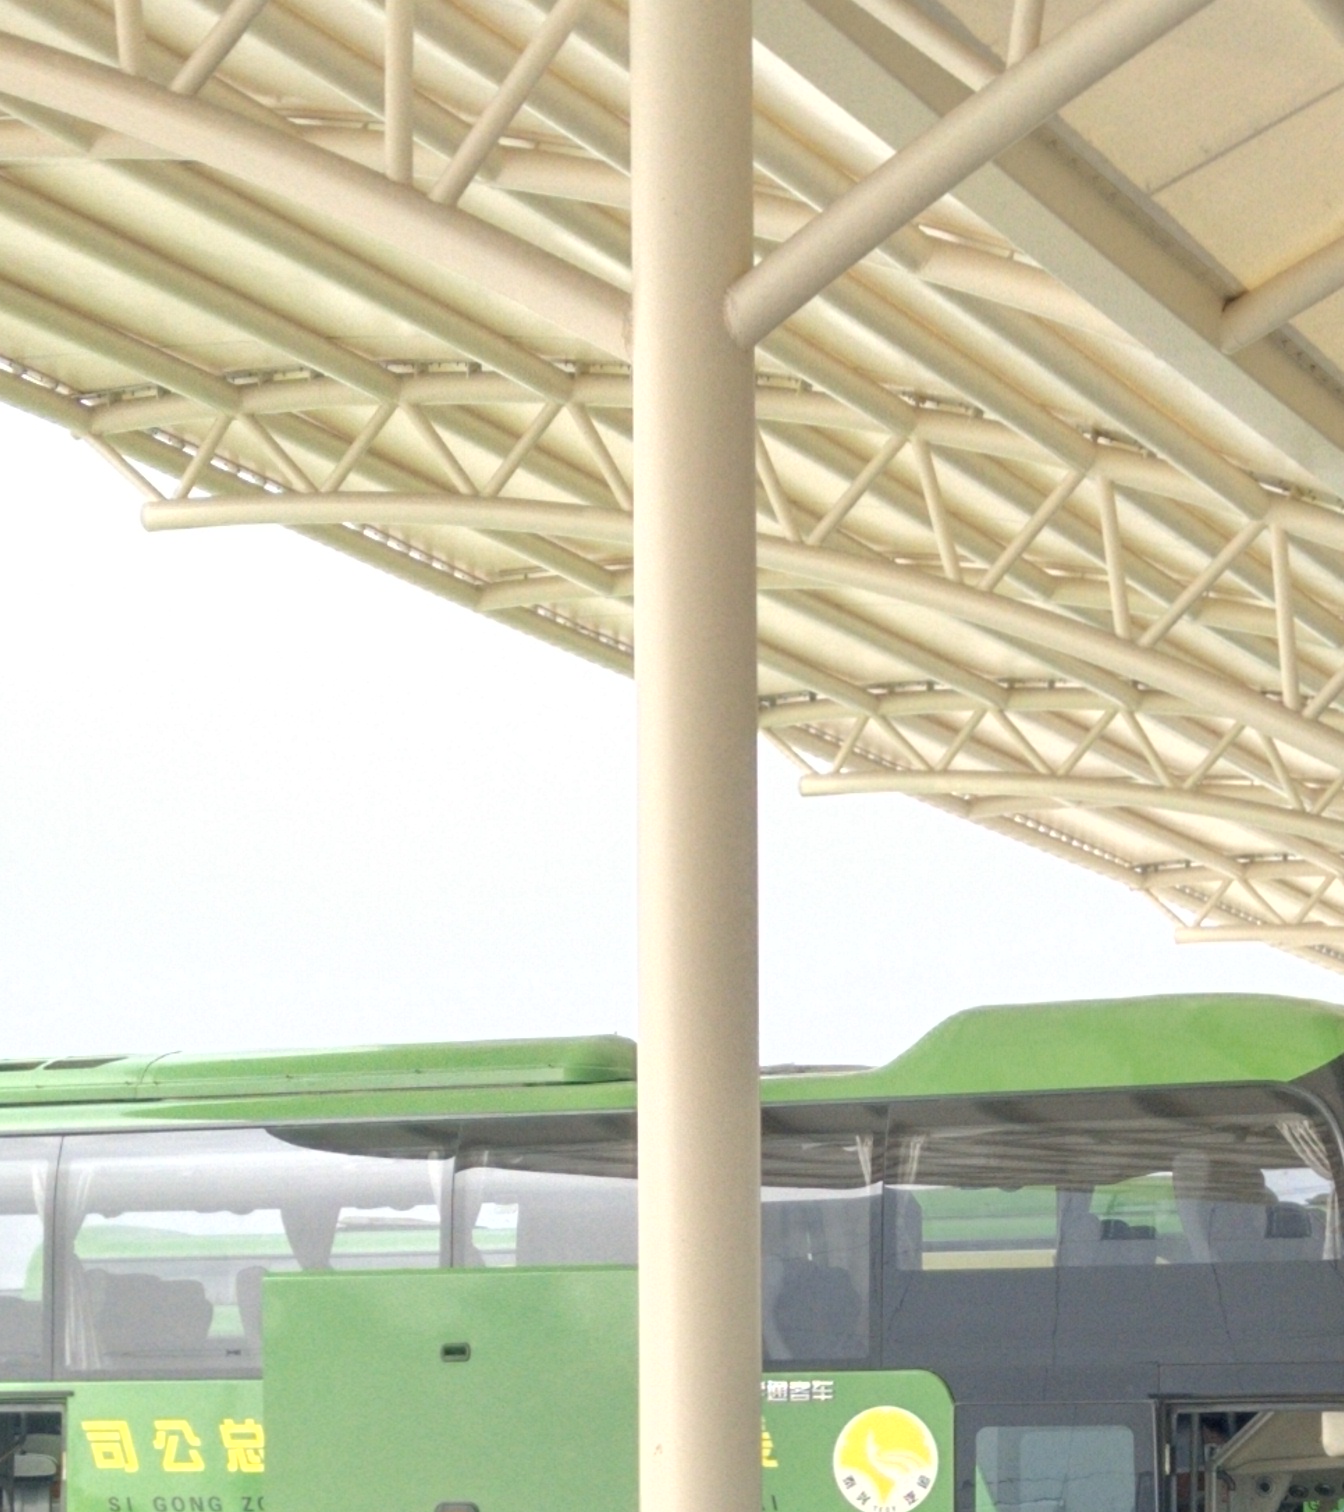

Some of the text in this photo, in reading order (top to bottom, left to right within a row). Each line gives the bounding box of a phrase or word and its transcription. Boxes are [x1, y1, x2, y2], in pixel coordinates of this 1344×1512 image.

[761, 1380, 834, 1401] 通客车
[108, 1496, 133, 1512] SI
[153, 1496, 223, 1512] GONG
